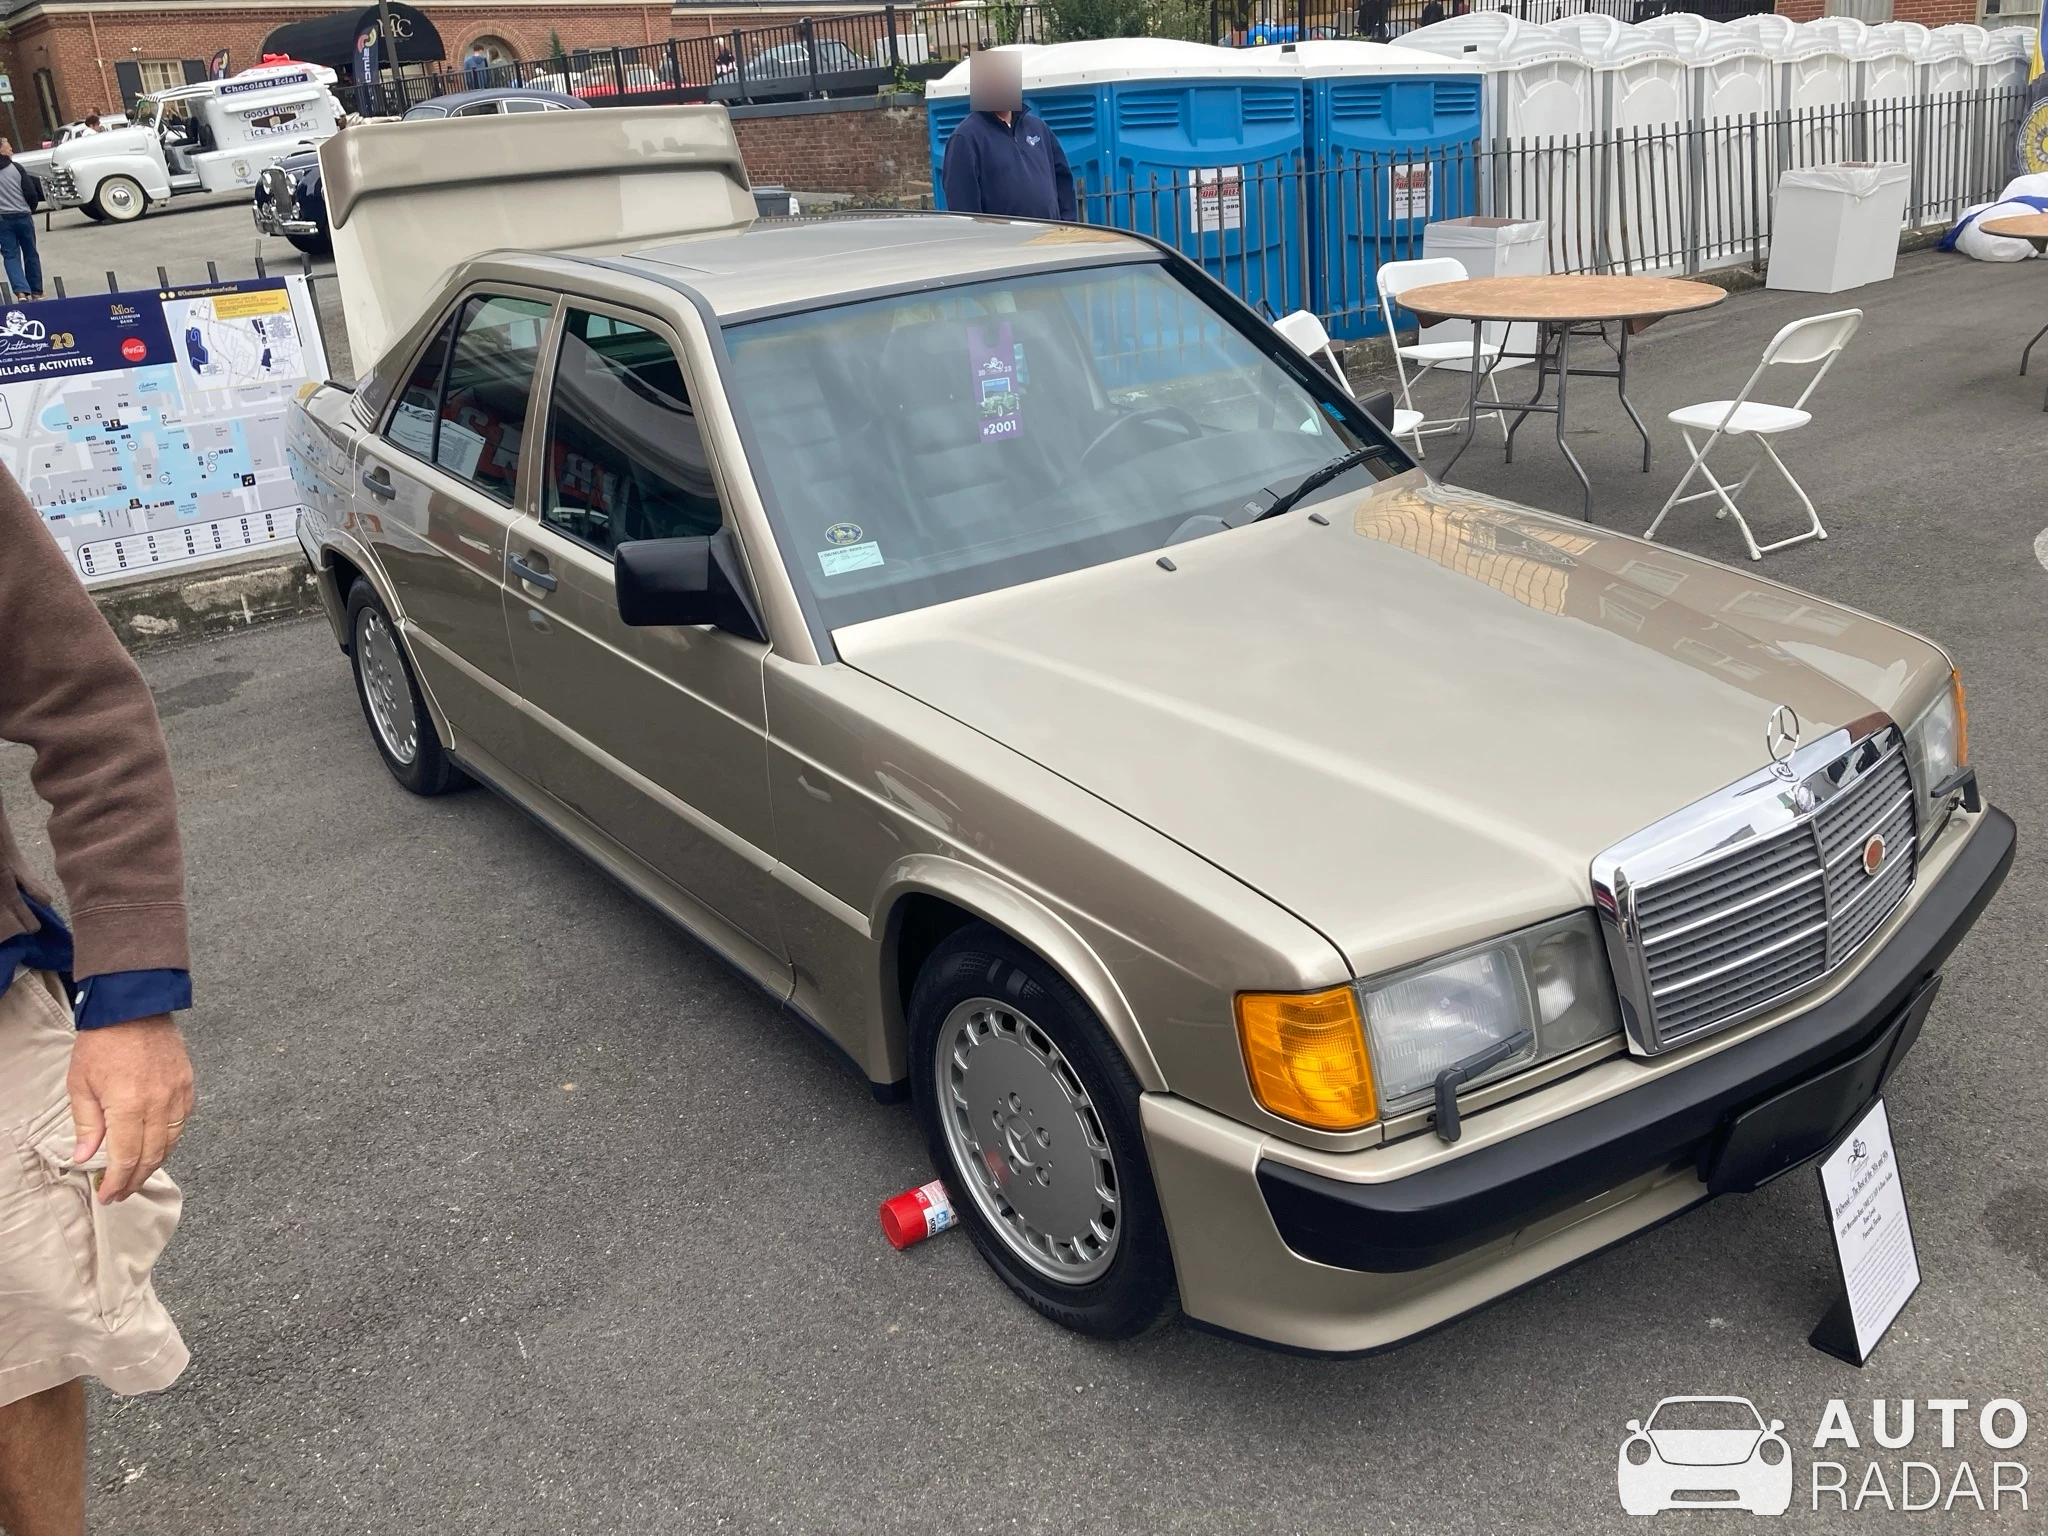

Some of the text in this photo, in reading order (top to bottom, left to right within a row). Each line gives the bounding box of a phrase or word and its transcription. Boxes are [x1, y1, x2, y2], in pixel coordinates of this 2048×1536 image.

[224, 74, 304, 94] Chocolate Eclair
[243, 103, 306, 119] Good Humor
[250, 121, 310, 137] ICE CREAM
[50, 332, 75, 350] 23
[0, 356, 94, 377] ILLAGE ACTIVITIES
[983, 420, 1017, 436] #2001
[915, 1191, 927, 1203] BC
